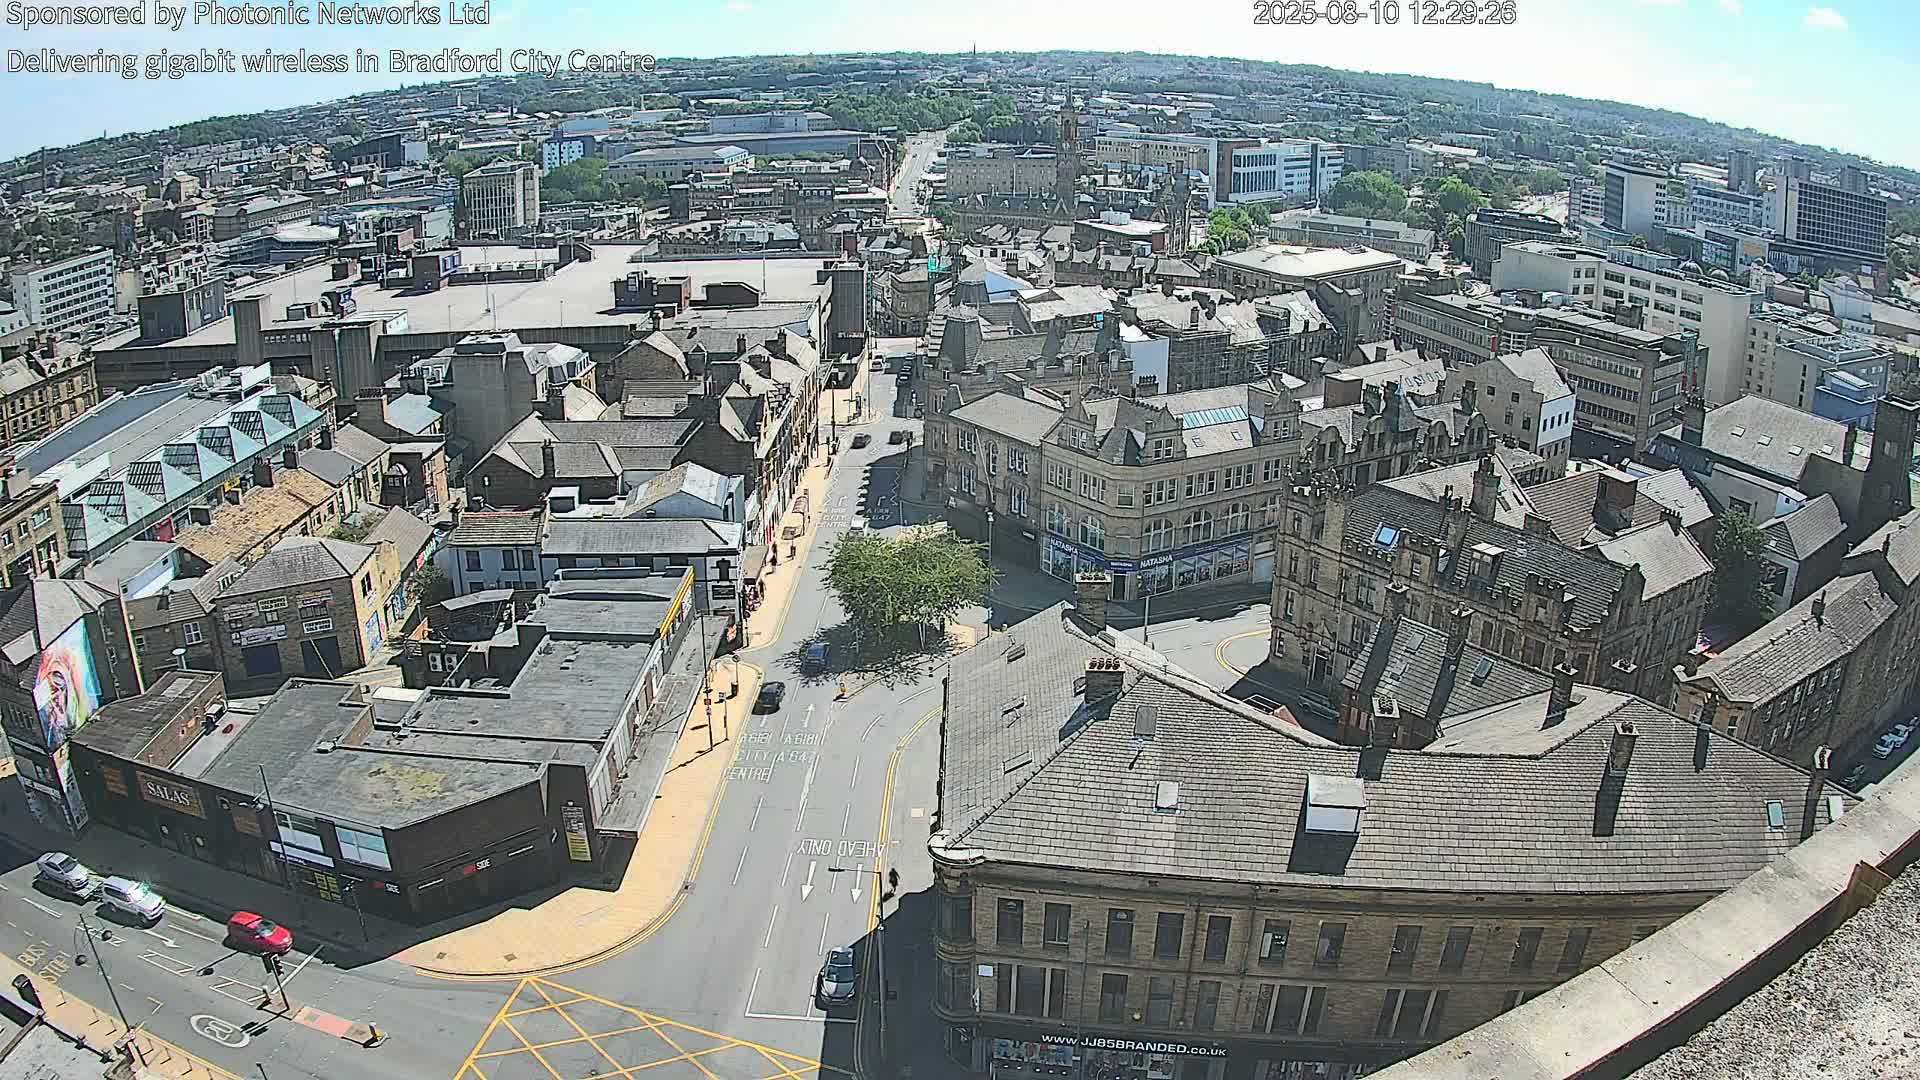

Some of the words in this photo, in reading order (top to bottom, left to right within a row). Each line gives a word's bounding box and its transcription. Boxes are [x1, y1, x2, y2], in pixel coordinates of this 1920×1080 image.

[1050, 537, 1079, 555] NATASHA
[1139, 554, 1174, 570] NATASHA
[146, 781, 191, 807] SALAS
[797, 838, 832, 857] ONLY
[837, 839, 886, 858] AHEAD
[203, 1020, 233, 1041] 20
[1041, 1034, 1078, 1046] www
